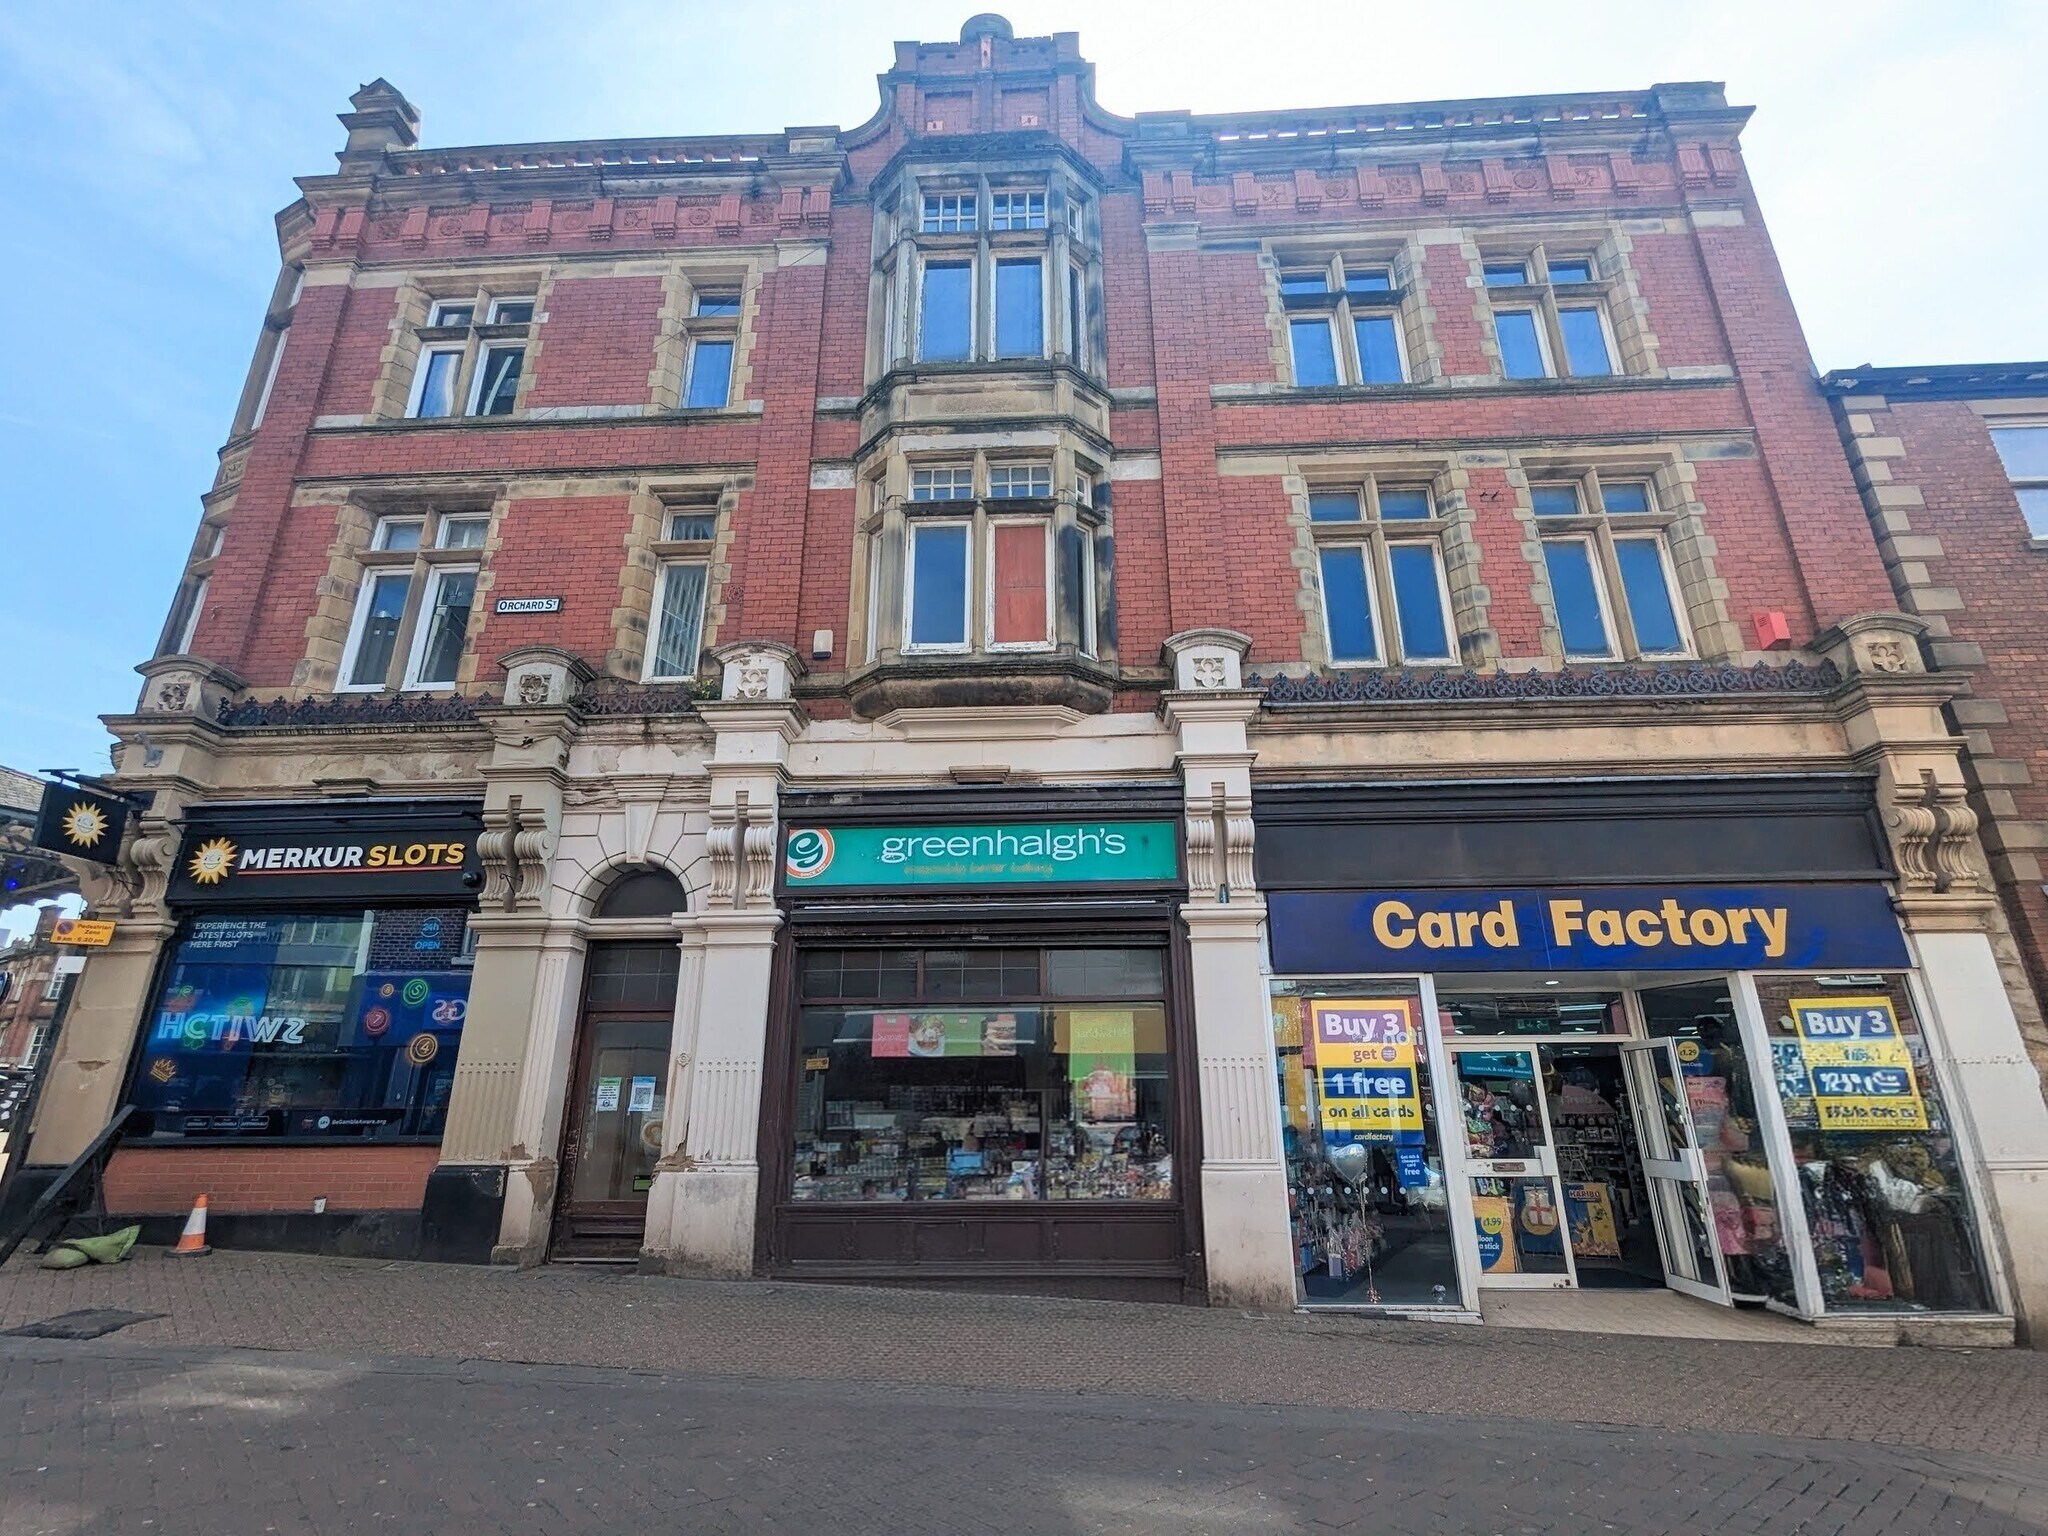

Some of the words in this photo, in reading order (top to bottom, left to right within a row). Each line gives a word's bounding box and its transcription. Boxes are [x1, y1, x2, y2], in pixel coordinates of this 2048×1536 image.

[500, 601, 544, 611] ORCHARD
[881, 828, 1126, 863] greenhalgh's
[240, 846, 364, 870] MERKUR
[366, 843, 466, 866] SLOTS
[195, 922, 248, 930] EXPERIENCE
[422, 922, 439, 932] 24h
[1372, 900, 1518, 950] Card
[1548, 899, 1788, 958] Factory
[226, 931, 254, 939] SLOTS
[190, 940, 212, 948] HERE
[214, 940, 240, 948] FIRST
[414, 940, 442, 950] OPEN
[1324, 1013, 1377, 1042] Buy
[1382, 1013, 1400, 1036] 3
[1805, 1012, 1862, 1040] Buy
[1866, 1010, 1887, 1033] 3
[1353, 1048, 1378, 1064] get
[1332, 1074, 1345, 1094] 1
[1351, 1072, 1406, 1095] free
[1328, 1107, 1348, 1118] on
[1351, 1104, 1370, 1118] all
[1373, 1104, 1415, 1118] cards
[1354, 1132, 1394, 1142] cardfactory
[1404, 1168, 1420, 1176] free
[1568, 1190, 1600, 1198] HARIBO
[1484, 1242, 1500, 1250] stick
